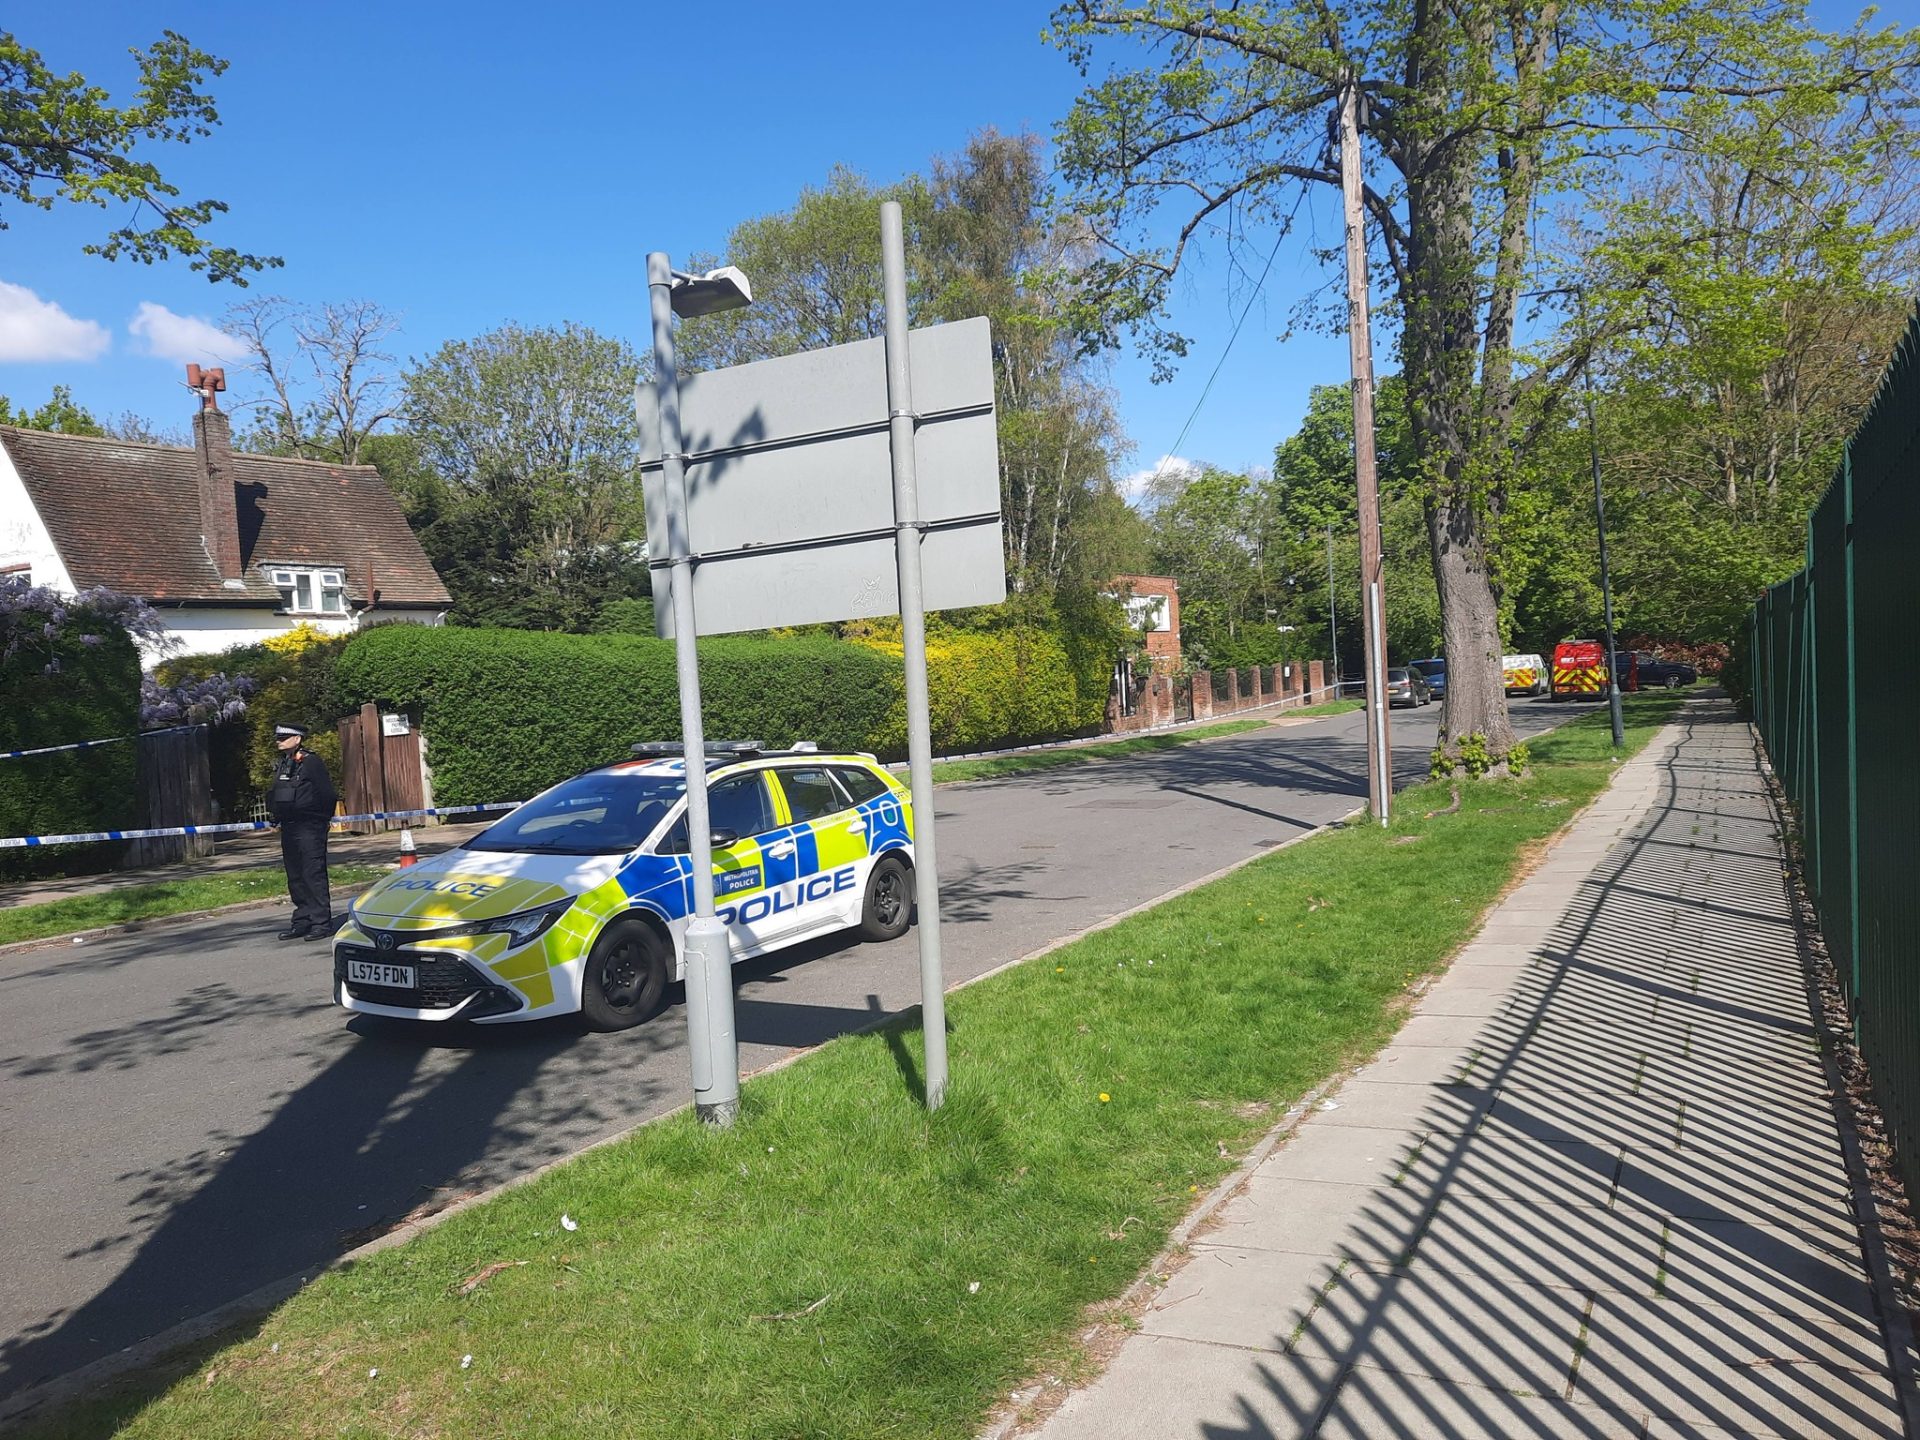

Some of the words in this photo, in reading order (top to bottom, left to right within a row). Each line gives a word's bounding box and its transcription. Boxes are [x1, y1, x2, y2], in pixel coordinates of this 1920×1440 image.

[388, 880, 497, 898] POLICE
[730, 878, 755, 890] POLICE
[716, 866, 856, 925] POLICE
[352, 963, 381, 982] LS75
[383, 966, 408, 985] FDN
